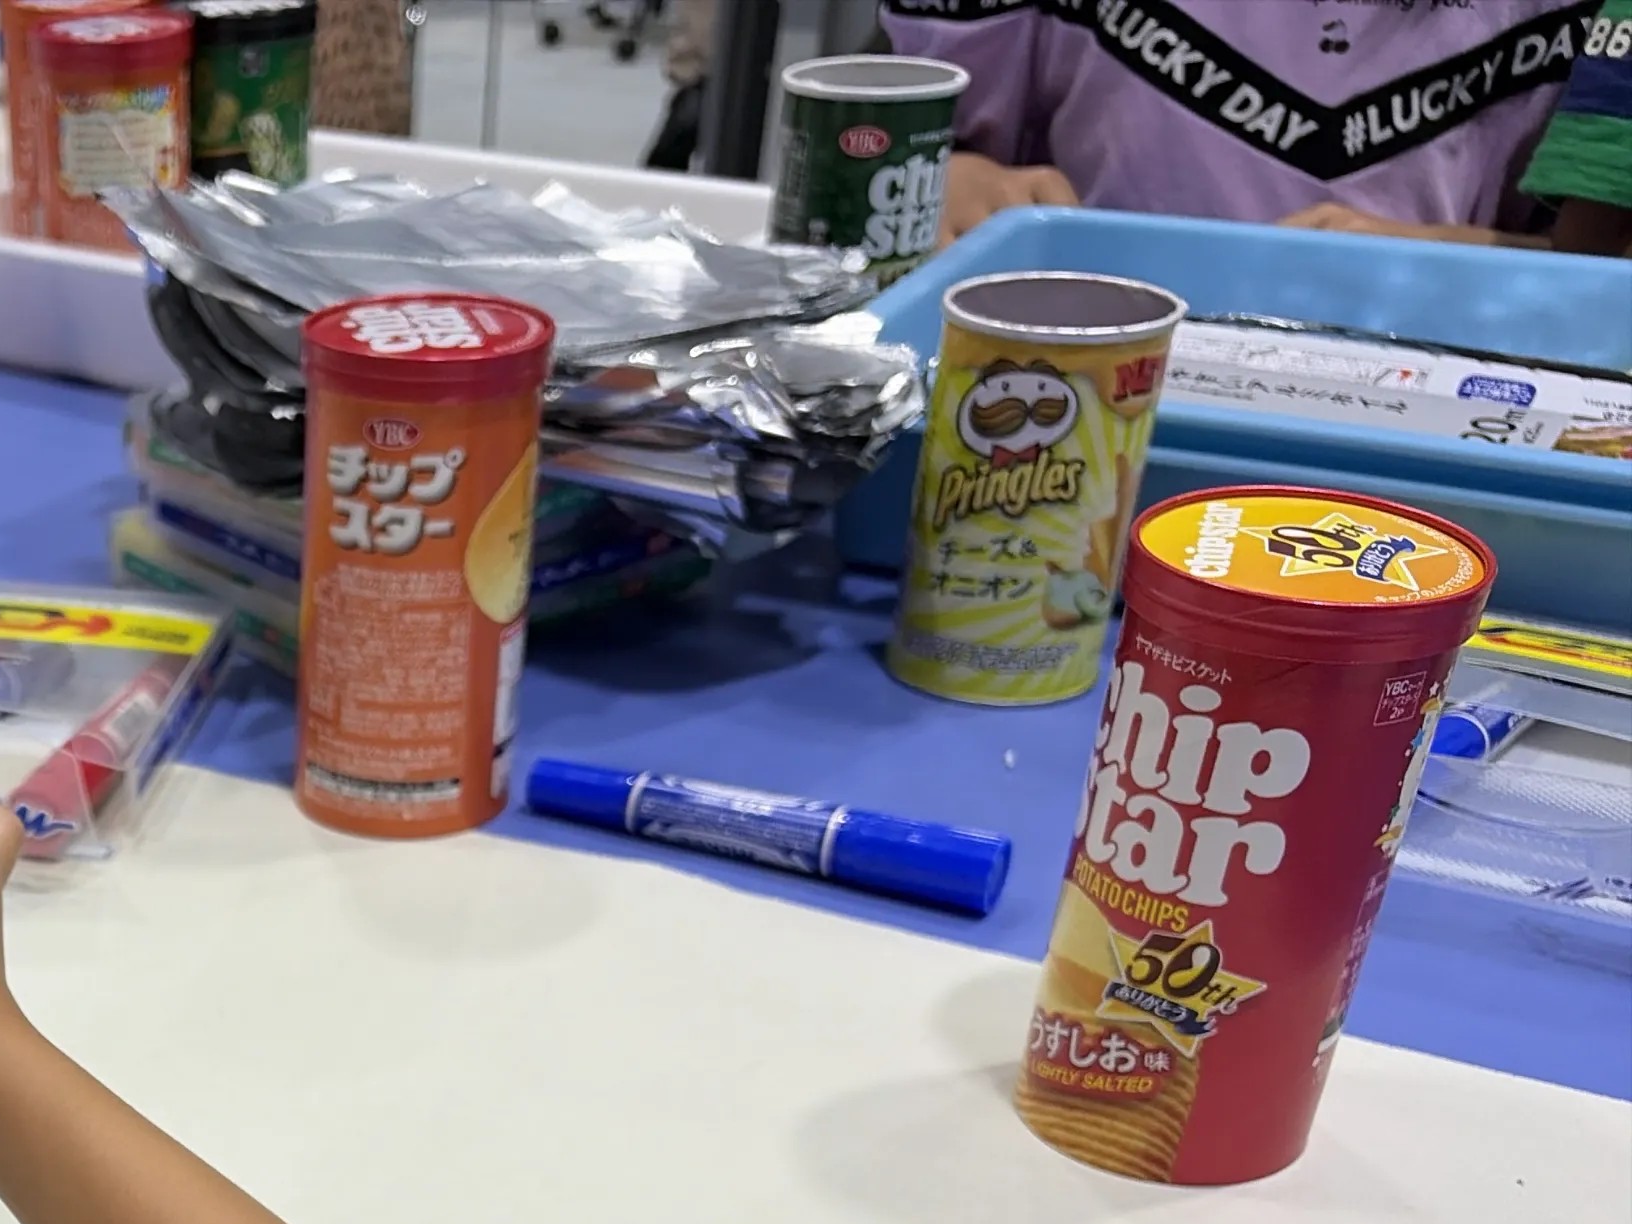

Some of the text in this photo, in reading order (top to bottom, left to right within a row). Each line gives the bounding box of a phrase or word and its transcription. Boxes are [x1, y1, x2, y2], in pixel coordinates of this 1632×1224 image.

[1219, 82, 1319, 150] DAY
[1342, 51, 1504, 157] #LUCKY
[865, 211, 944, 259] sta
[373, 421, 411, 446] YBC
[327, 445, 466, 505] チップ
[932, 449, 1087, 532] Pringles
[328, 496, 454, 555] スター
[1268, 523, 1374, 567] 50th
[1358, 543, 1395, 577] ありがとう
[931, 572, 1034, 601] オニオン
[1135, 632, 1233, 686] ヤマザキビスケット
[1122, 888, 1190, 933] CHIPS
[1125, 933, 1237, 1015] 50th
[1114, 984, 1188, 1023] ありがとう
[1030, 1010, 1170, 1073] うすしお味
[1081, 1071, 1153, 1093] SALTED
